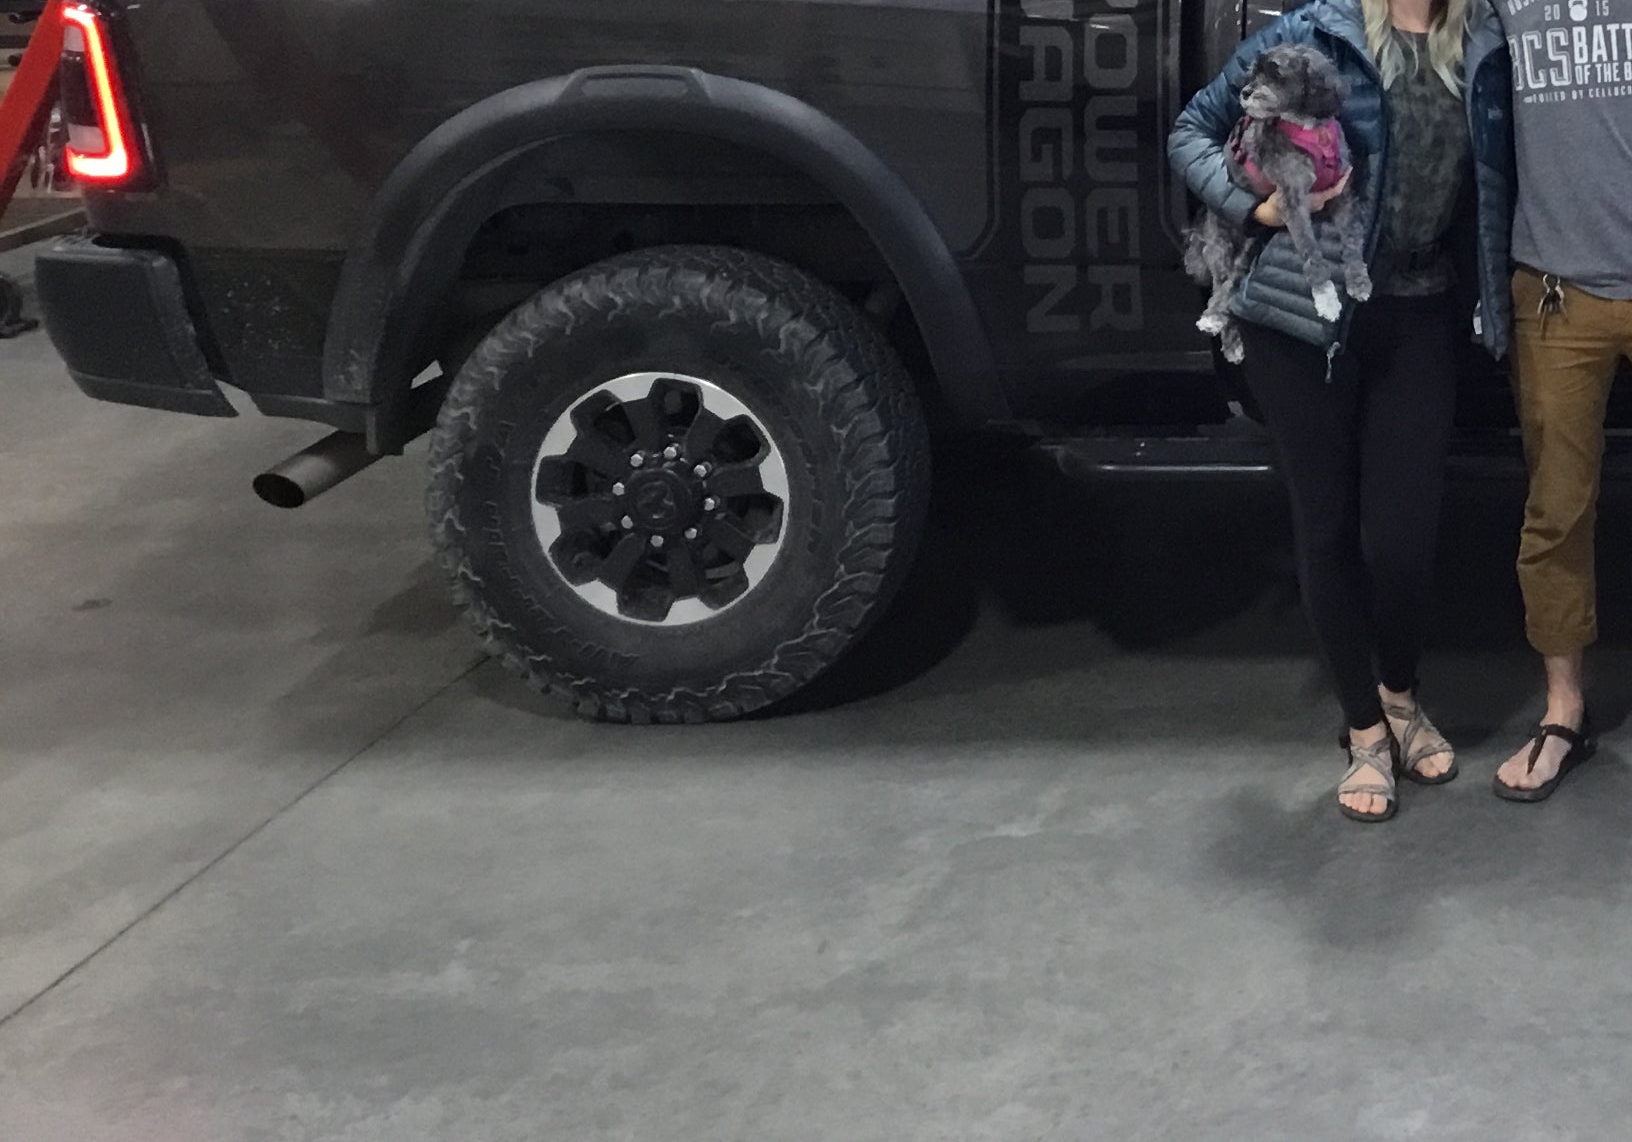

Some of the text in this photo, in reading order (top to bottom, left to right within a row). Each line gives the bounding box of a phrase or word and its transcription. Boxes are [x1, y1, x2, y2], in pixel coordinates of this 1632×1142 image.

[1544, 0, 1610, 21] 20 15
[1574, 64, 1592, 85] OF
[1595, 61, 1621, 84] THE
